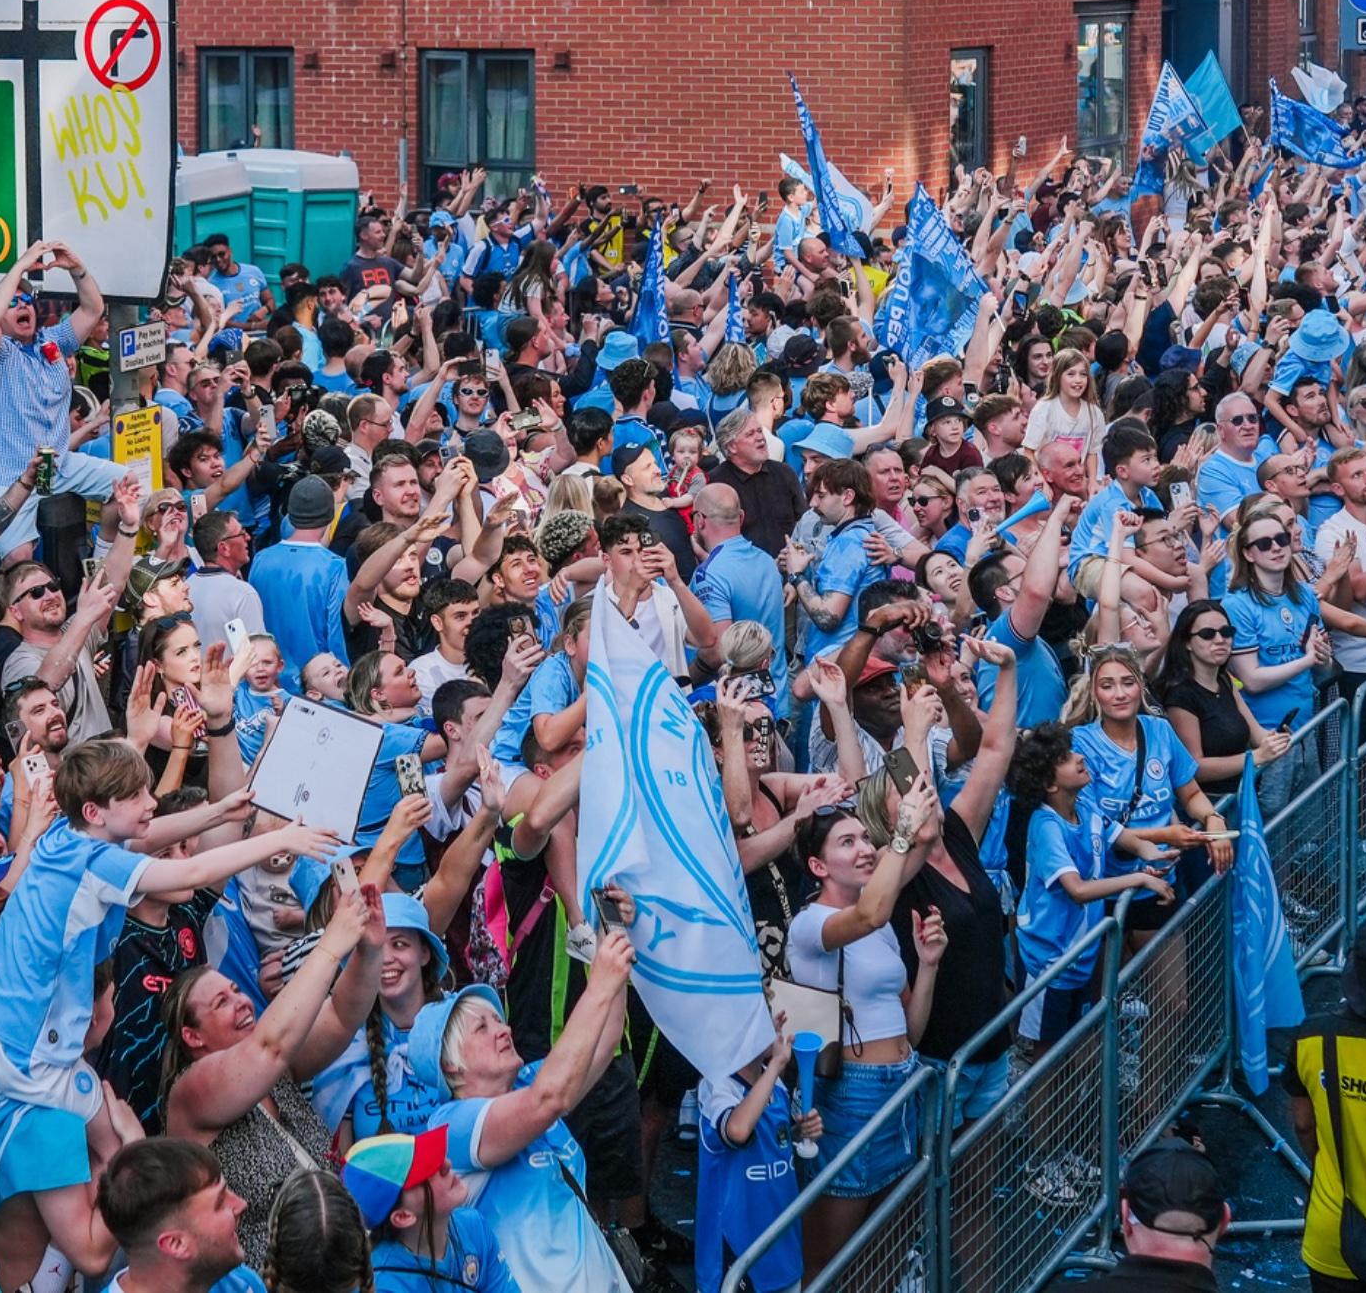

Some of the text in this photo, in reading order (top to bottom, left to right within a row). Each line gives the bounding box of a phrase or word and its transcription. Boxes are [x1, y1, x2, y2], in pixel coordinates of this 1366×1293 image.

[138, 330, 149, 340] Pay
[149, 328, 161, 337] here
[143, 338, 164, 348] machine
[145, 352, 162, 363] ticket
[664, 769, 688, 788] 18
[745, 1156, 795, 1181] EID
